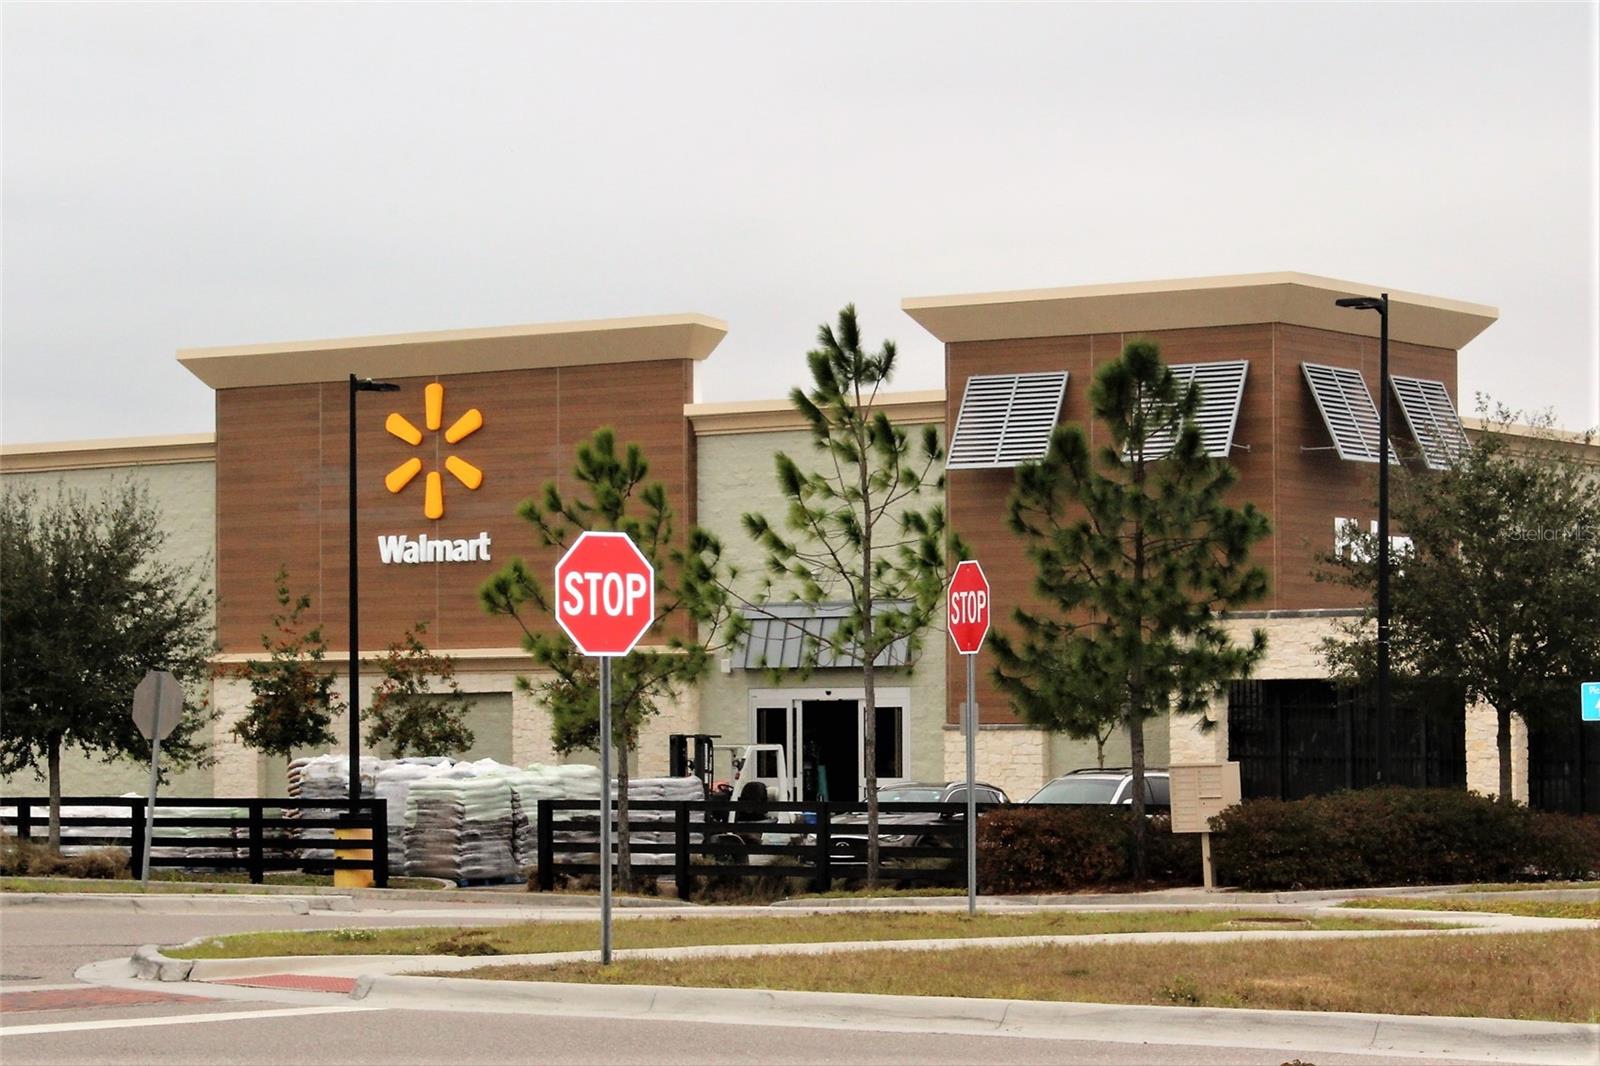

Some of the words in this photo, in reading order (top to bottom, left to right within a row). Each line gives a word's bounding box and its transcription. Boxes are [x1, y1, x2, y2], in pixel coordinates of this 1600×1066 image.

[377, 531, 491, 564] Walmart
[563, 571, 647, 617] STOP
[951, 590, 986, 625] STOP
